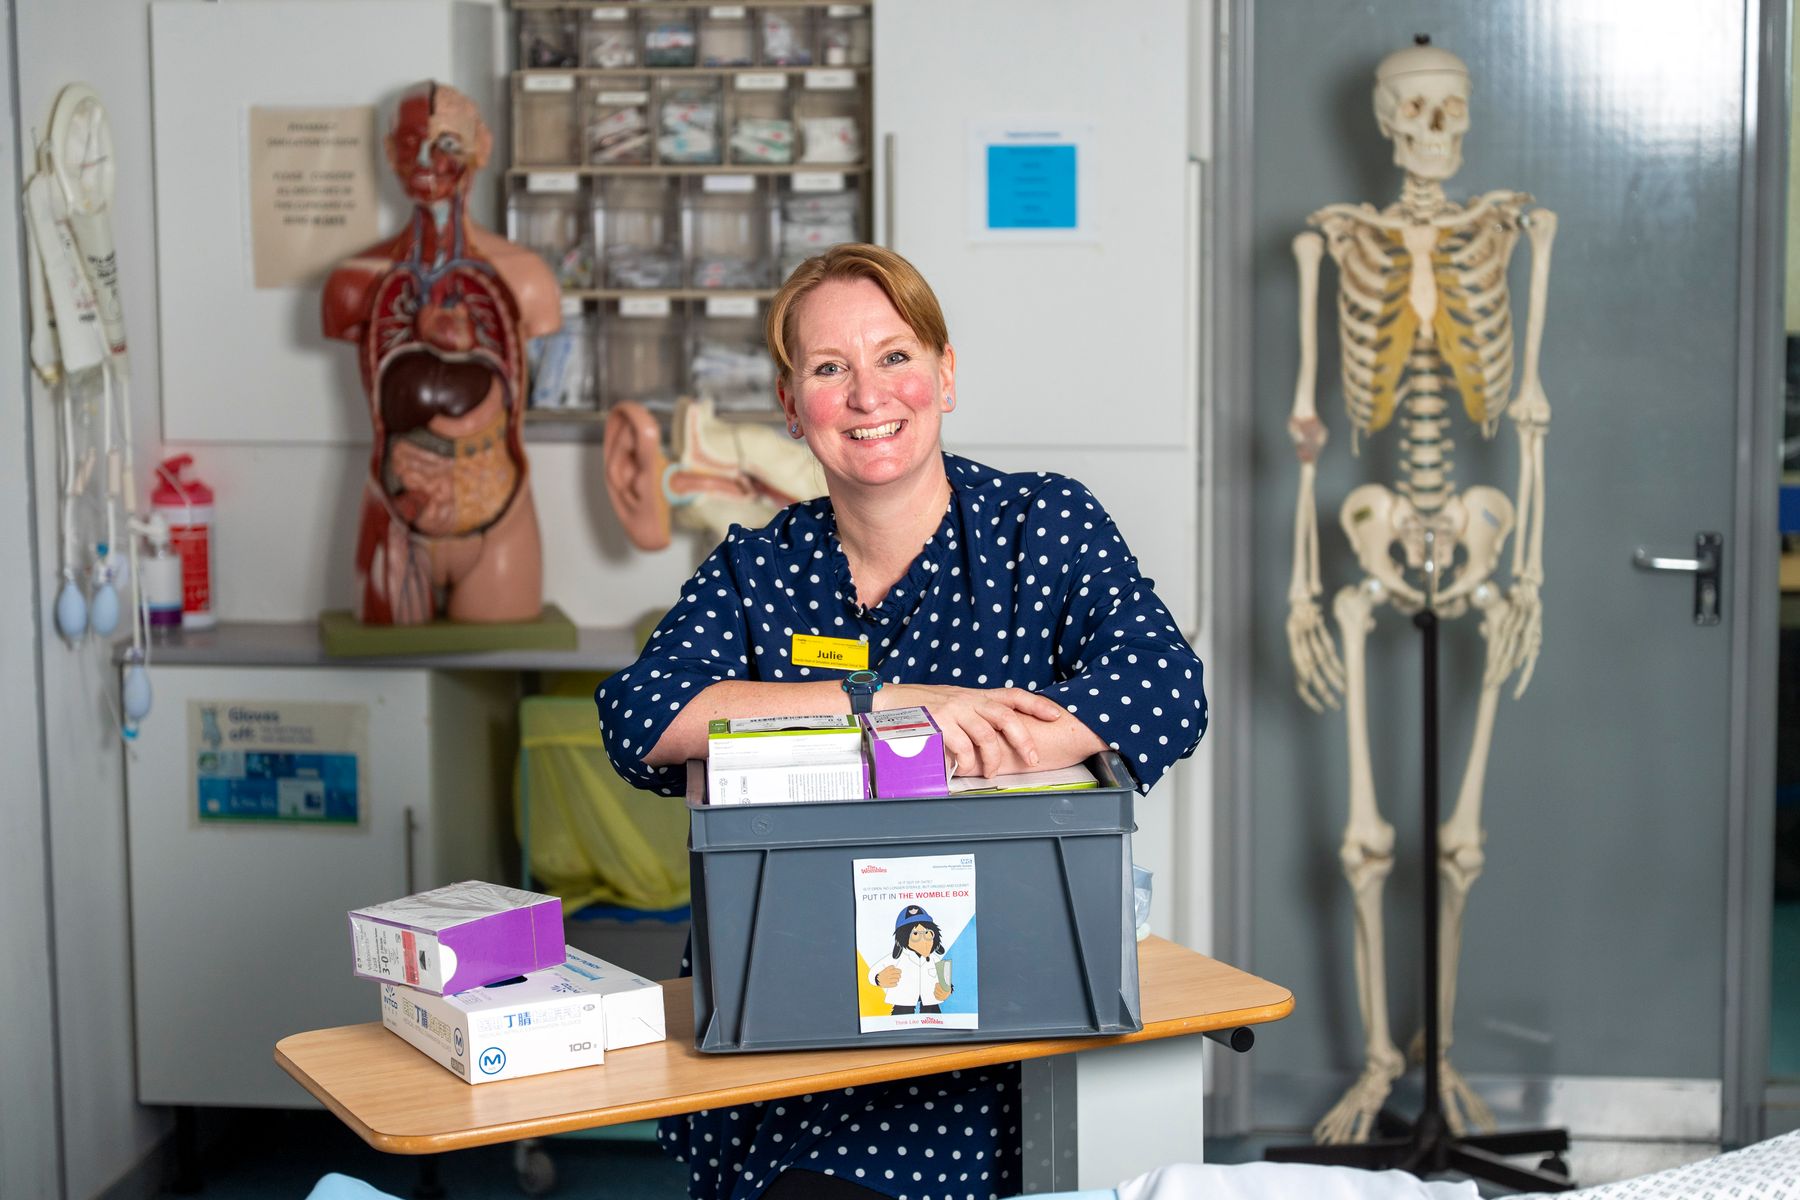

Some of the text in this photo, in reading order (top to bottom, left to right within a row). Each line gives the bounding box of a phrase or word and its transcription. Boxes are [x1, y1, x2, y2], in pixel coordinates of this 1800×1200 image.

[817, 650, 843, 660] Julie
[228, 707, 280, 723] Gloves
[381, 956, 390, 975] 3-0
[569, 1042, 591, 1052] 100
[484, 1054, 501, 1066] M
